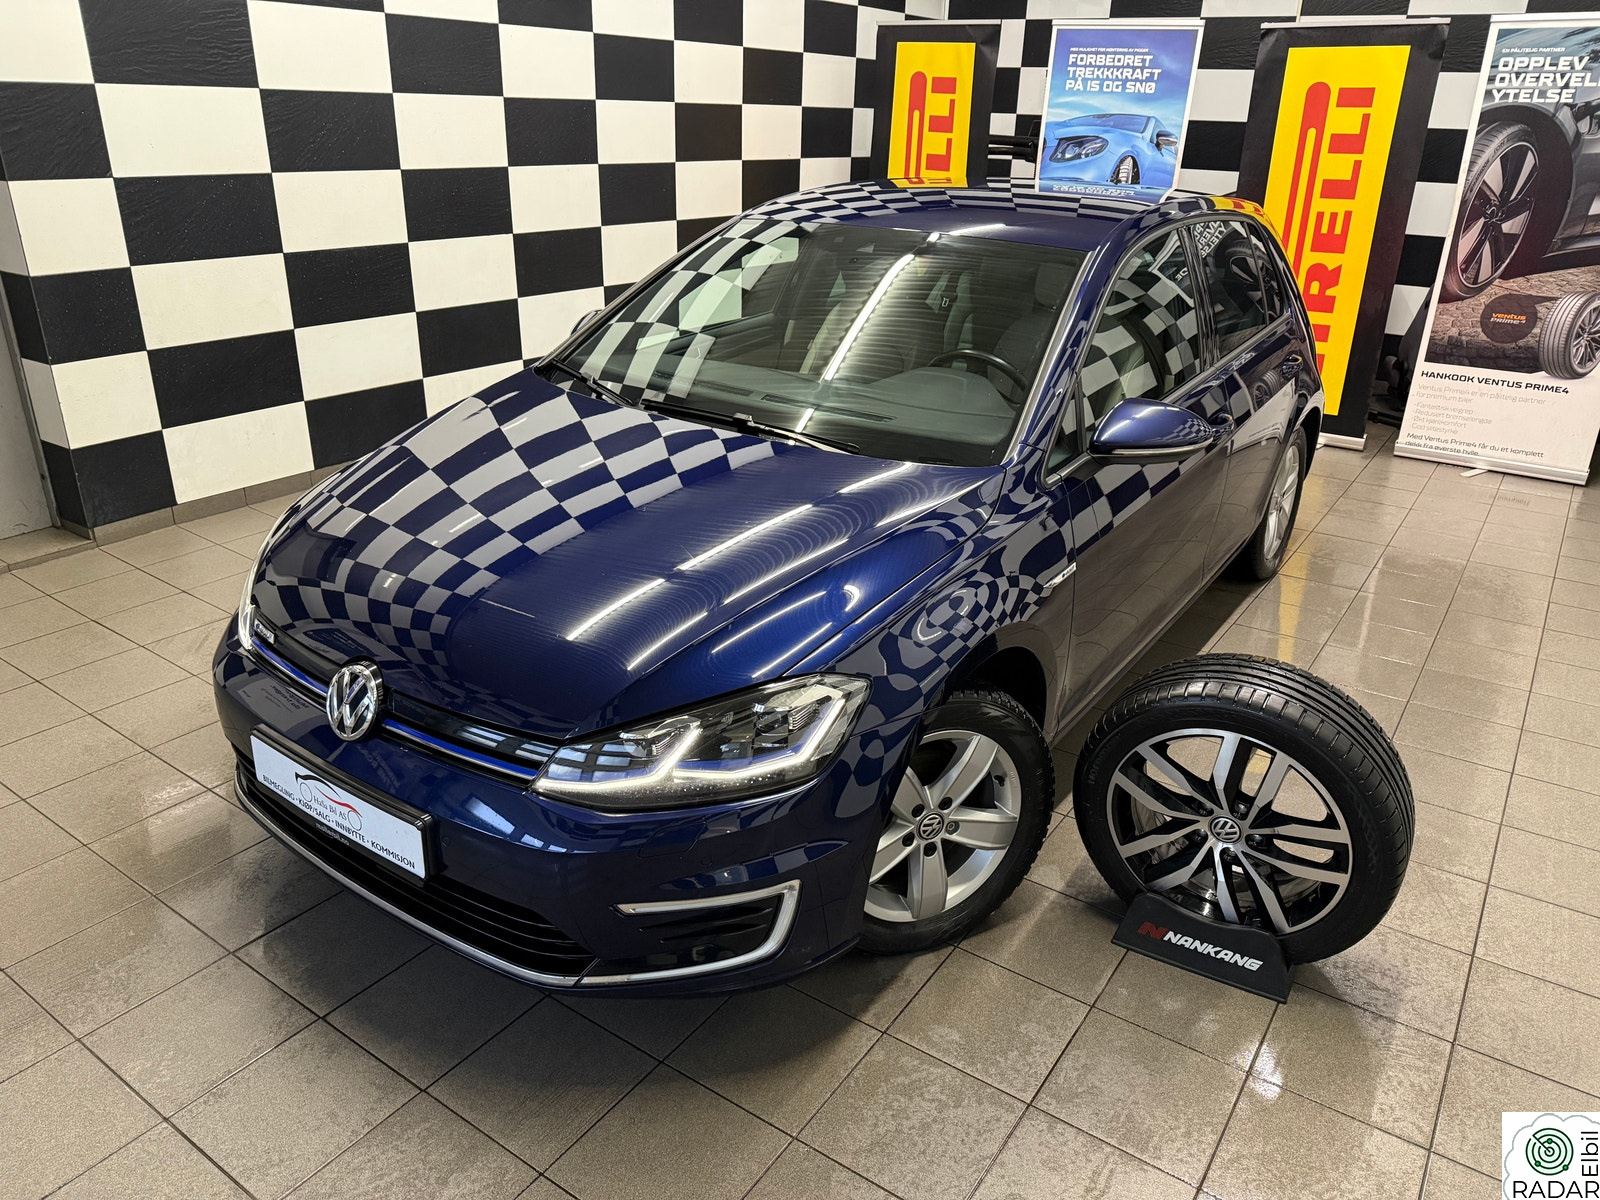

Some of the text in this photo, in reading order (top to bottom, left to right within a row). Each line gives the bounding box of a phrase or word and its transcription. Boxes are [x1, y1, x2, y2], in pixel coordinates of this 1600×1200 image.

[1068, 54, 1154, 66] FORBEDRET
[1498, 56, 1590, 71] OPPLEV
[1067, 67, 1162, 80] TREKKKRAFT
[1494, 72, 1600, 87] OVERVEL
[1065, 77, 1156, 94] PÅ IS OG SNØ
[1492, 89, 1576, 103] YTELSE
[1421, 370, 1569, 394] HANKOOK VENTUS PRIME4
[1418, 384, 1442, 392] Ventus
[1518, 397, 1546, 405] partner
[1426, 394, 1457, 402] premium
[1407, 432, 1423, 440] Med
[1424, 435, 1449, 444] Ventus
[1450, 439, 1476, 447] Prime4
[1510, 448, 1544, 458] komplett
[262, 774, 415, 869] BILMEGLING KJØP/SALG INNBYTTE KOMMISJON
[1163, 931, 1264, 971] NANKANG
